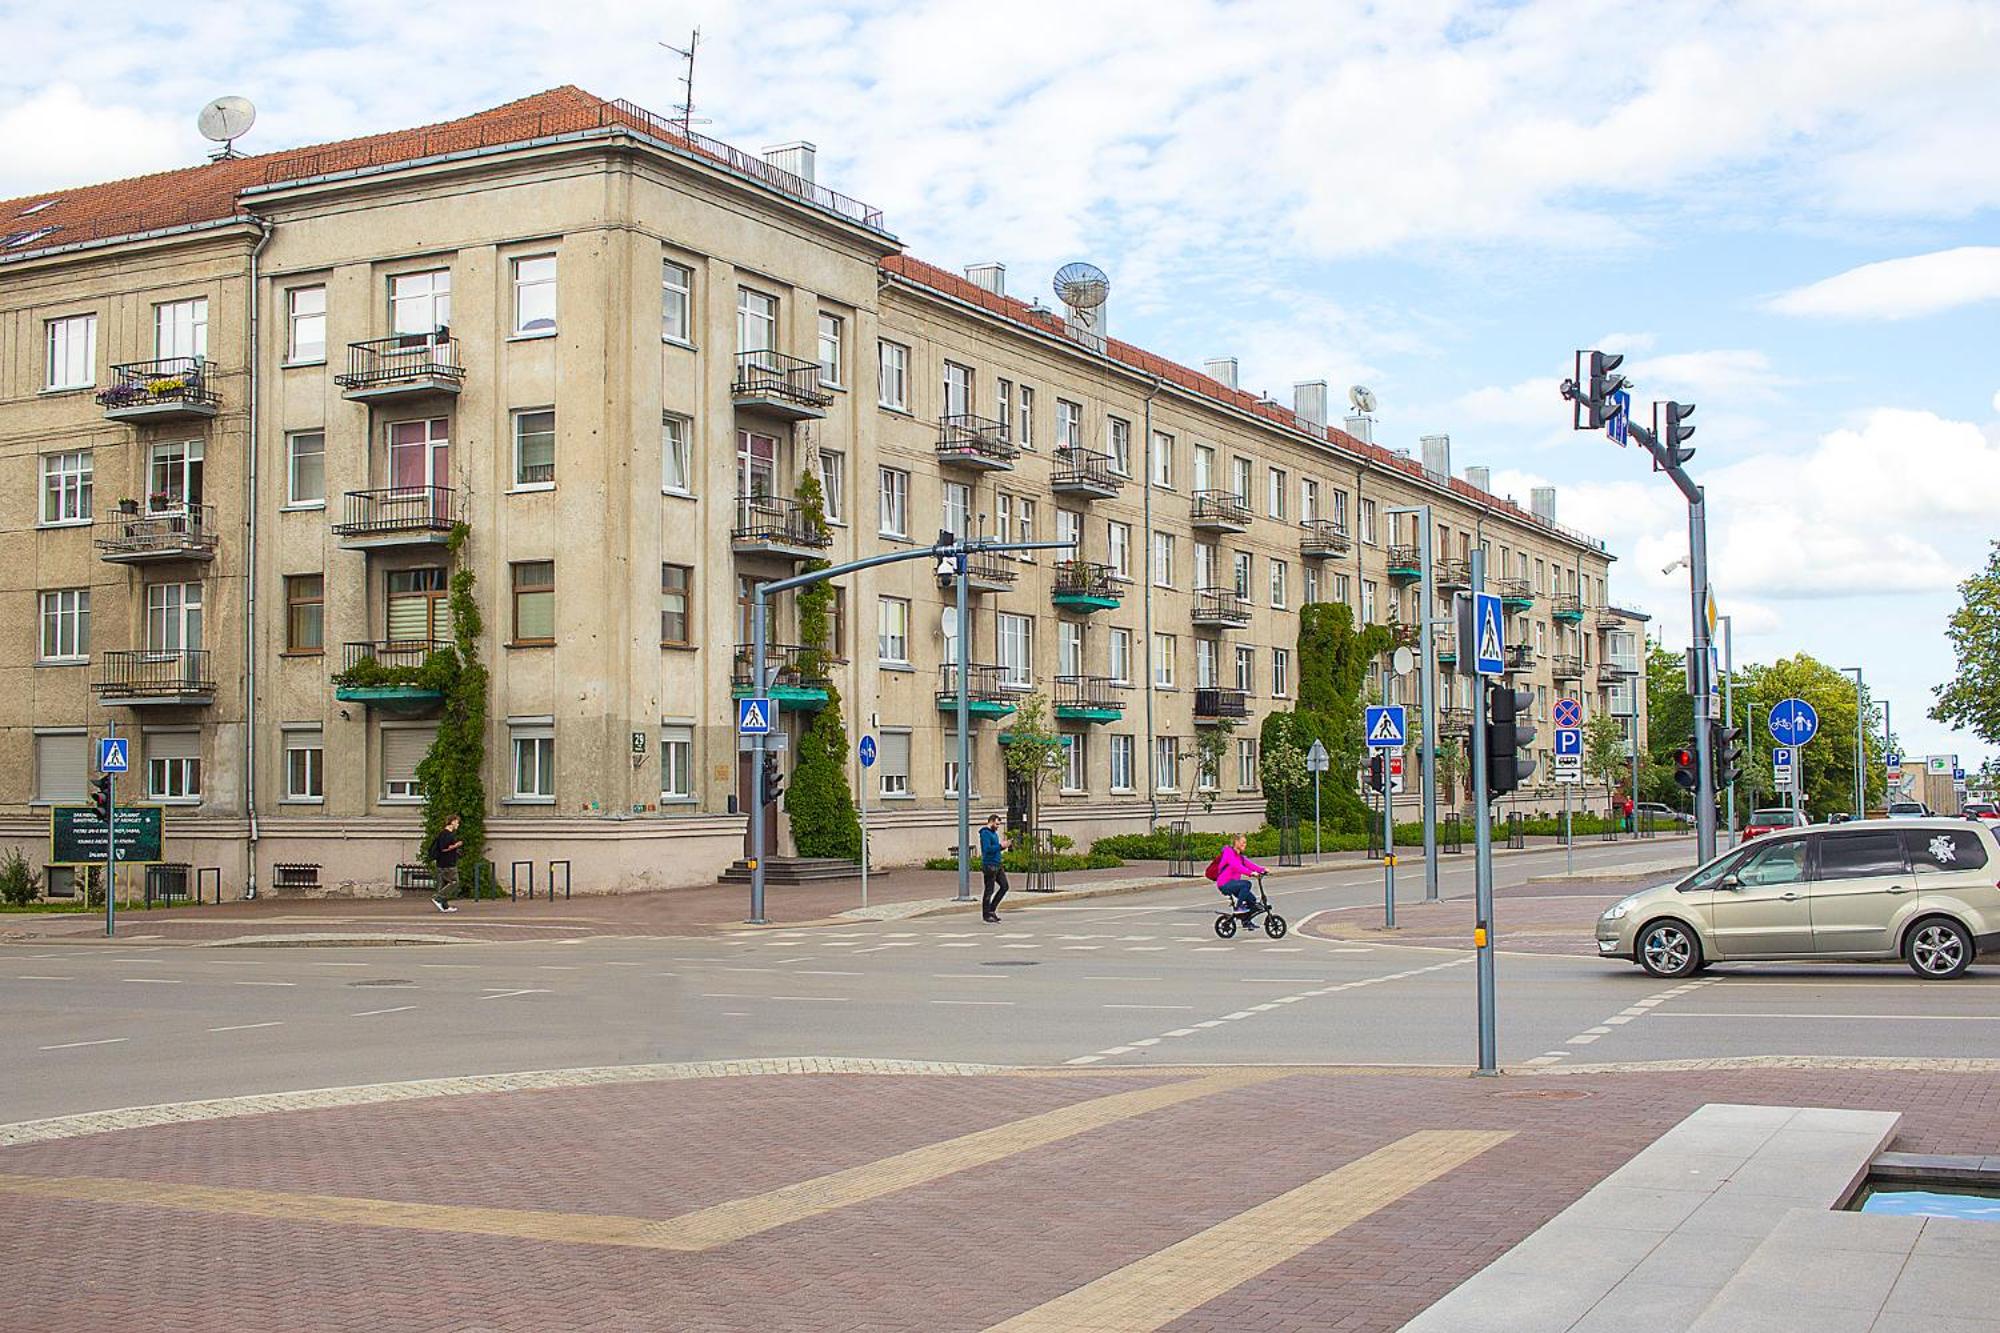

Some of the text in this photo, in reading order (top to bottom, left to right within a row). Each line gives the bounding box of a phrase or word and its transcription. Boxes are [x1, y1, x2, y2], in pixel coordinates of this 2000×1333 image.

[635, 734, 644, 745] 29
[1562, 731, 1576, 753] P
[1778, 750, 1788, 764] P
[1890, 755, 1898, 765] P
[1956, 770, 1963, 778] P
